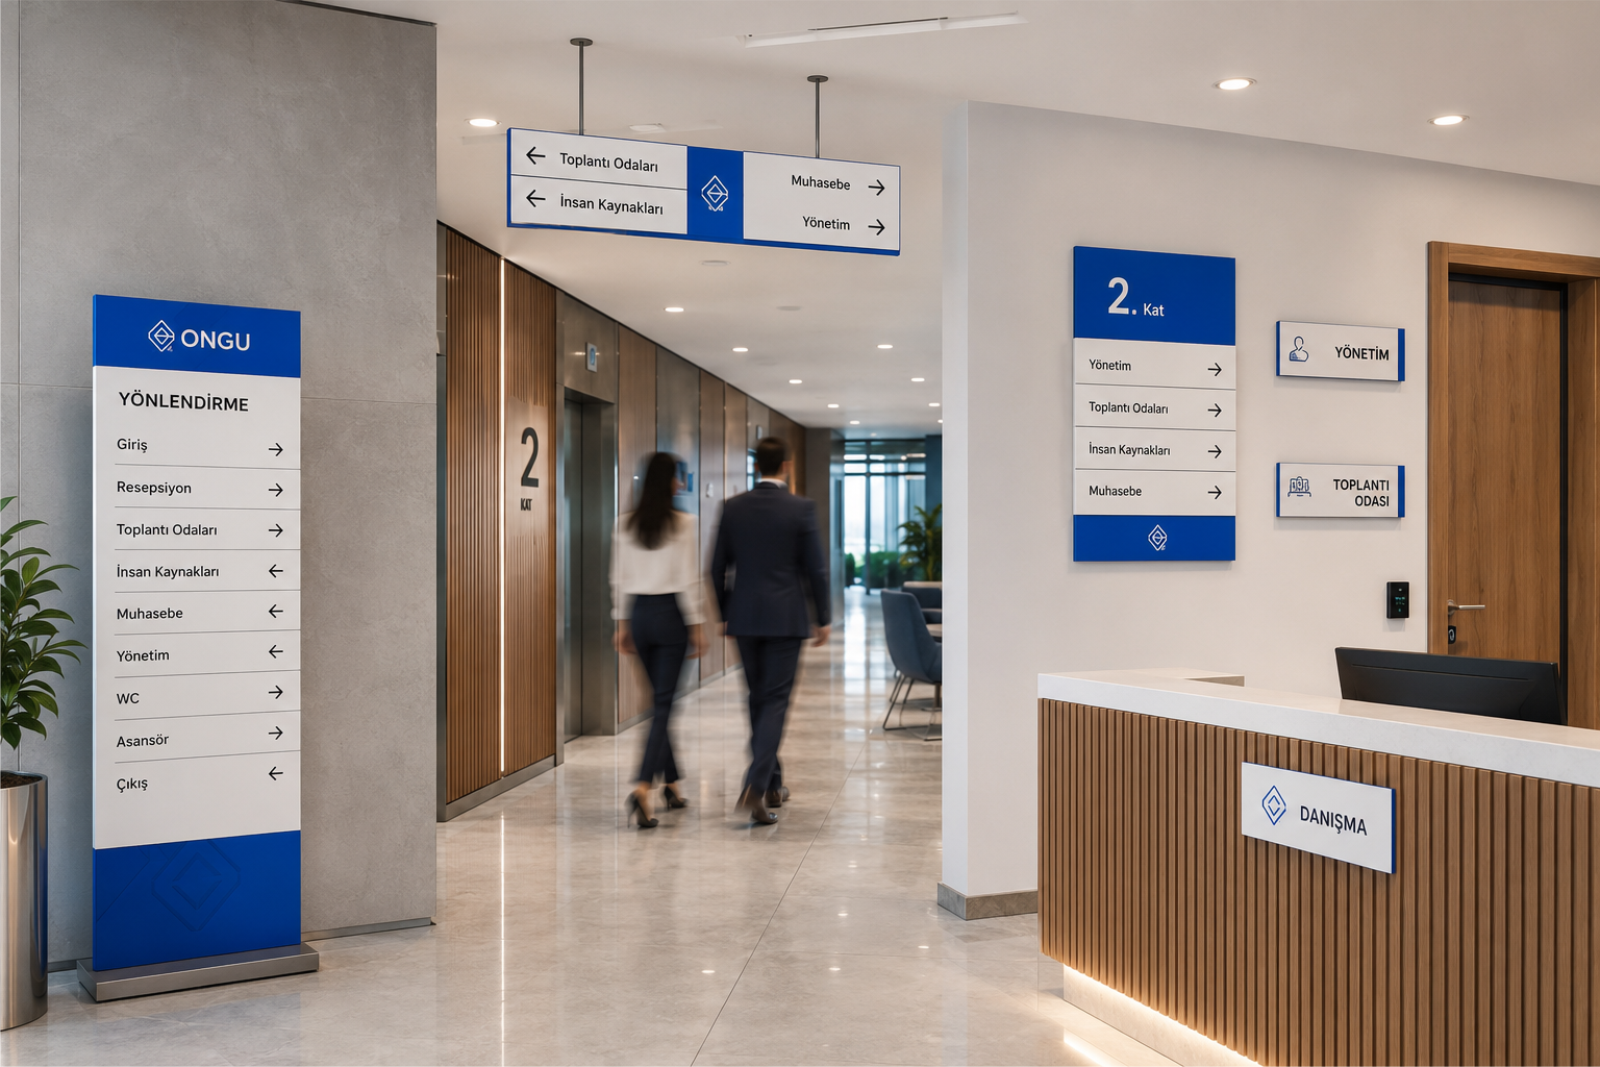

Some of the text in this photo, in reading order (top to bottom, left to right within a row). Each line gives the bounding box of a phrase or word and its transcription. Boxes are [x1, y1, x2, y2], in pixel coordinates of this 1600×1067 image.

[560, 153, 657, 173] Toplantı Odaları
[792, 175, 850, 190] Muhasebe
[560, 194, 663, 215] İnsan Kaynakları
[802, 216, 850, 230] Yönetim
[1108, 277, 1165, 317] 2. Kat
[181, 329, 250, 351] ONGU
[1335, 345, 1390, 361] YÖNETİM
[1089, 359, 1131, 371] Yönetim
[118, 390, 249, 412] YÖNLENDİRME
[1089, 401, 1169, 415] Toplantı Odaları
[117, 438, 148, 453] Giriş
[1089, 441, 1171, 457] İnsan Kaynakları
[520, 427, 539, 487] 2
[117, 481, 192, 497] Resepsiyon
[1089, 486, 1142, 497] Muhasebe
[1333, 479, 1390, 491] TOPLANTI
[1354, 496, 1390, 507] ODASI
[117, 523, 218, 538] Toplantı Odaları
[116, 564, 219, 580] İnsan Kaynakları
[116, 608, 184, 620] Muhasebe
[116, 650, 170, 663] Yönetim
[116, 692, 140, 704] WC
[116, 734, 170, 748] Asansör
[116, 777, 148, 793] Çıkış
[1300, 805, 1368, 835] DANIŞMA
